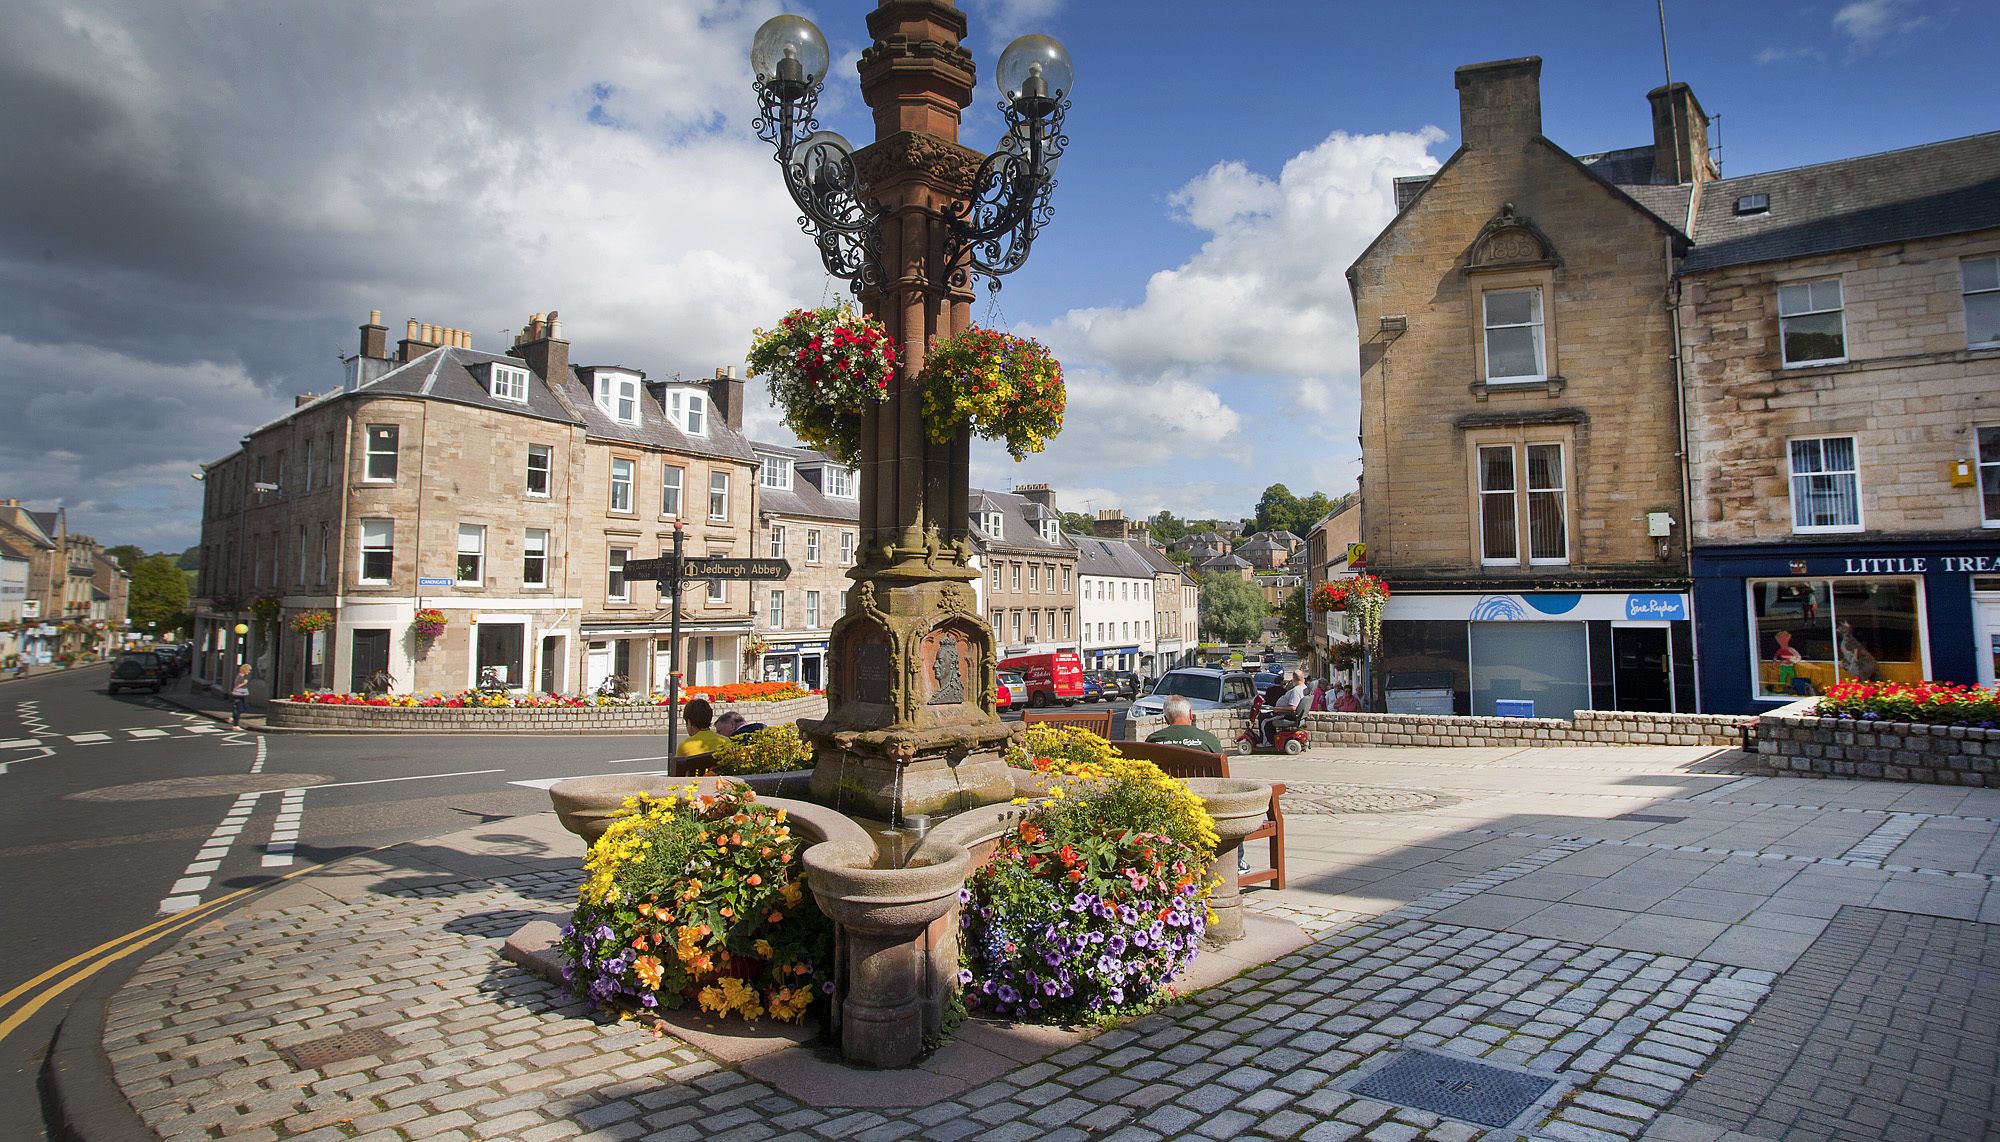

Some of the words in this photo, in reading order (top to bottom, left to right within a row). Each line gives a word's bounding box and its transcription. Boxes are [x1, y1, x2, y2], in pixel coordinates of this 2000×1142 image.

[701, 564, 745, 576] Jedburgh
[751, 564, 781, 577] Abbey
[1845, 557, 1927, 573] LITTLE
[1630, 598, 1649, 615] Sue
[1650, 599, 1679, 617] Ryder
